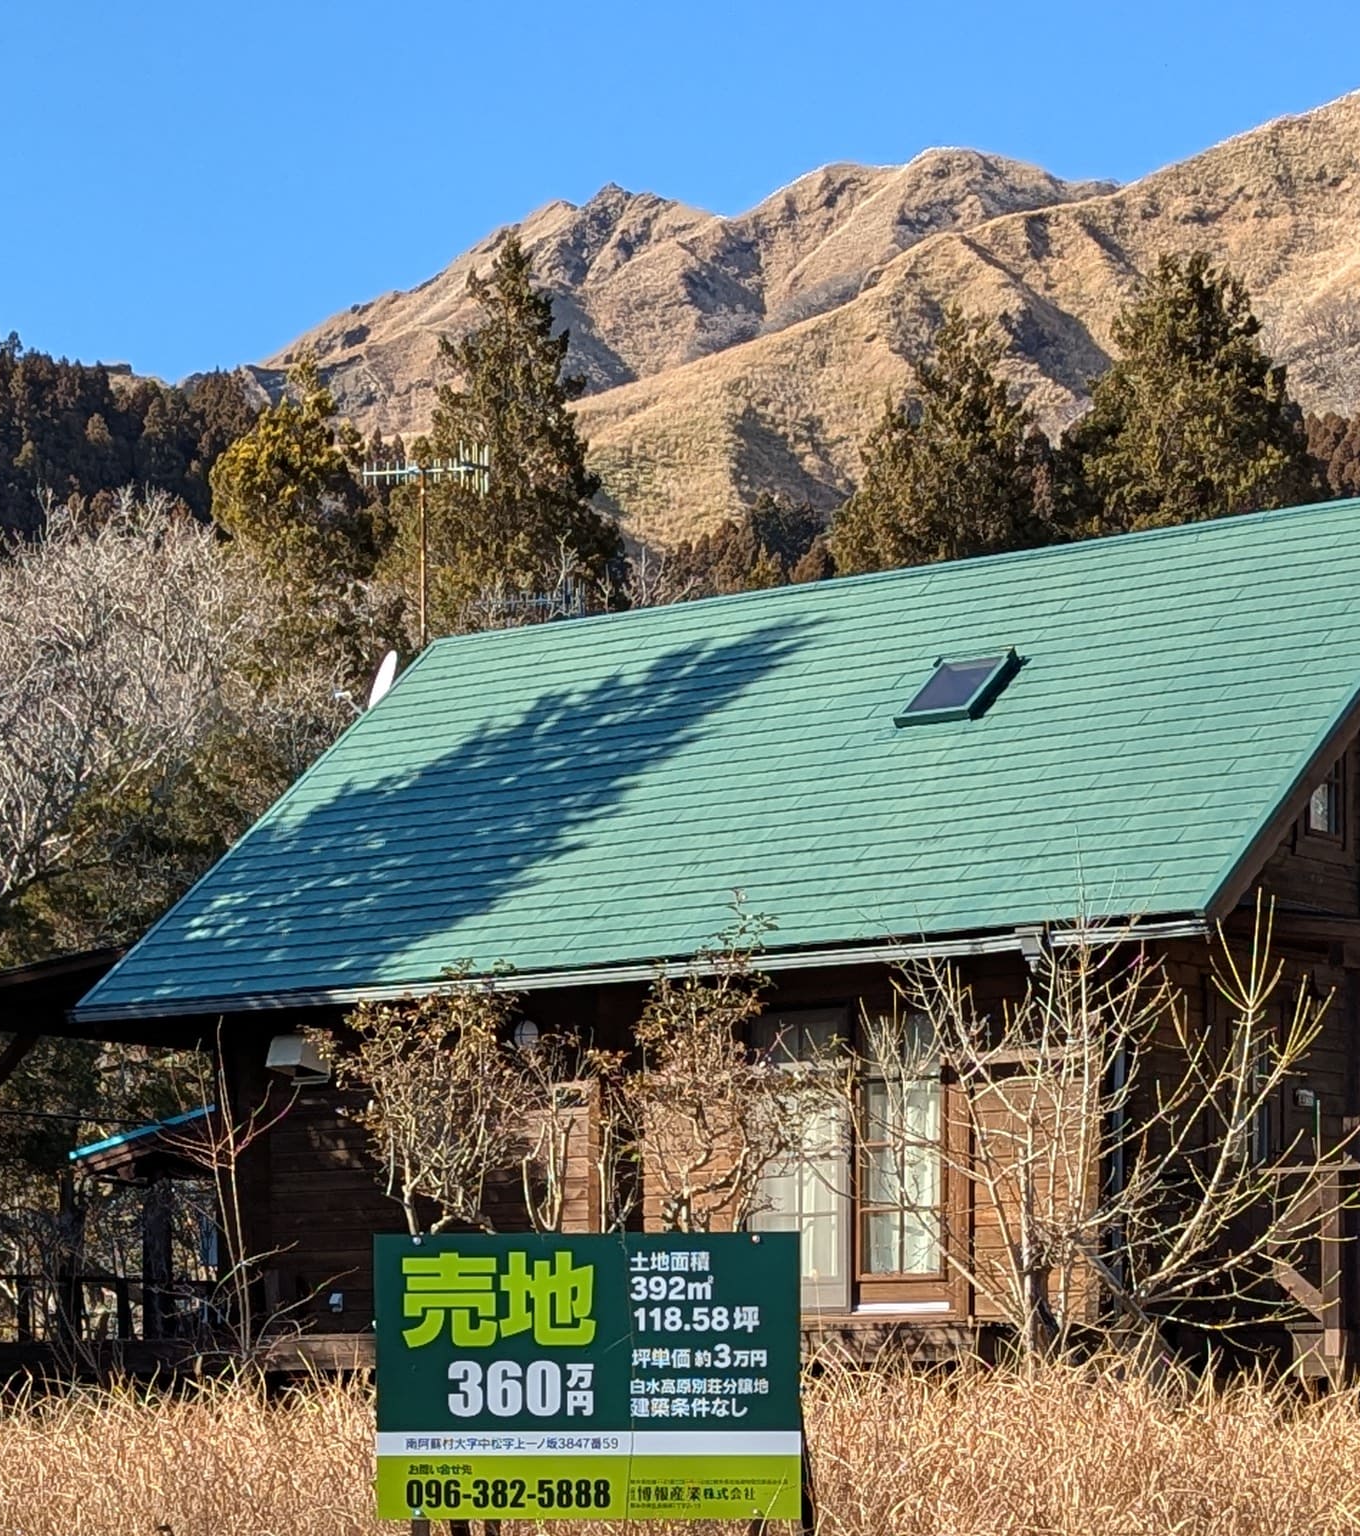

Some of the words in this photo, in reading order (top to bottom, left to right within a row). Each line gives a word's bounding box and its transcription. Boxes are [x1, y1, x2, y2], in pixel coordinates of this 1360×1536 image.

[630, 1251, 710, 1272] 土地面積
[402, 1251, 596, 1348] 売地
[630, 1275, 714, 1301] 392㎡
[633, 1306, 760, 1333] 118.58坪
[630, 1378, 769, 1394] 白水高原別荘分譲地
[630, 1397, 749, 1417] 建築条件なし
[407, 1463, 473, 1475] お問い合せ先
[406, 1478, 612, 1509] 096-382-5888
